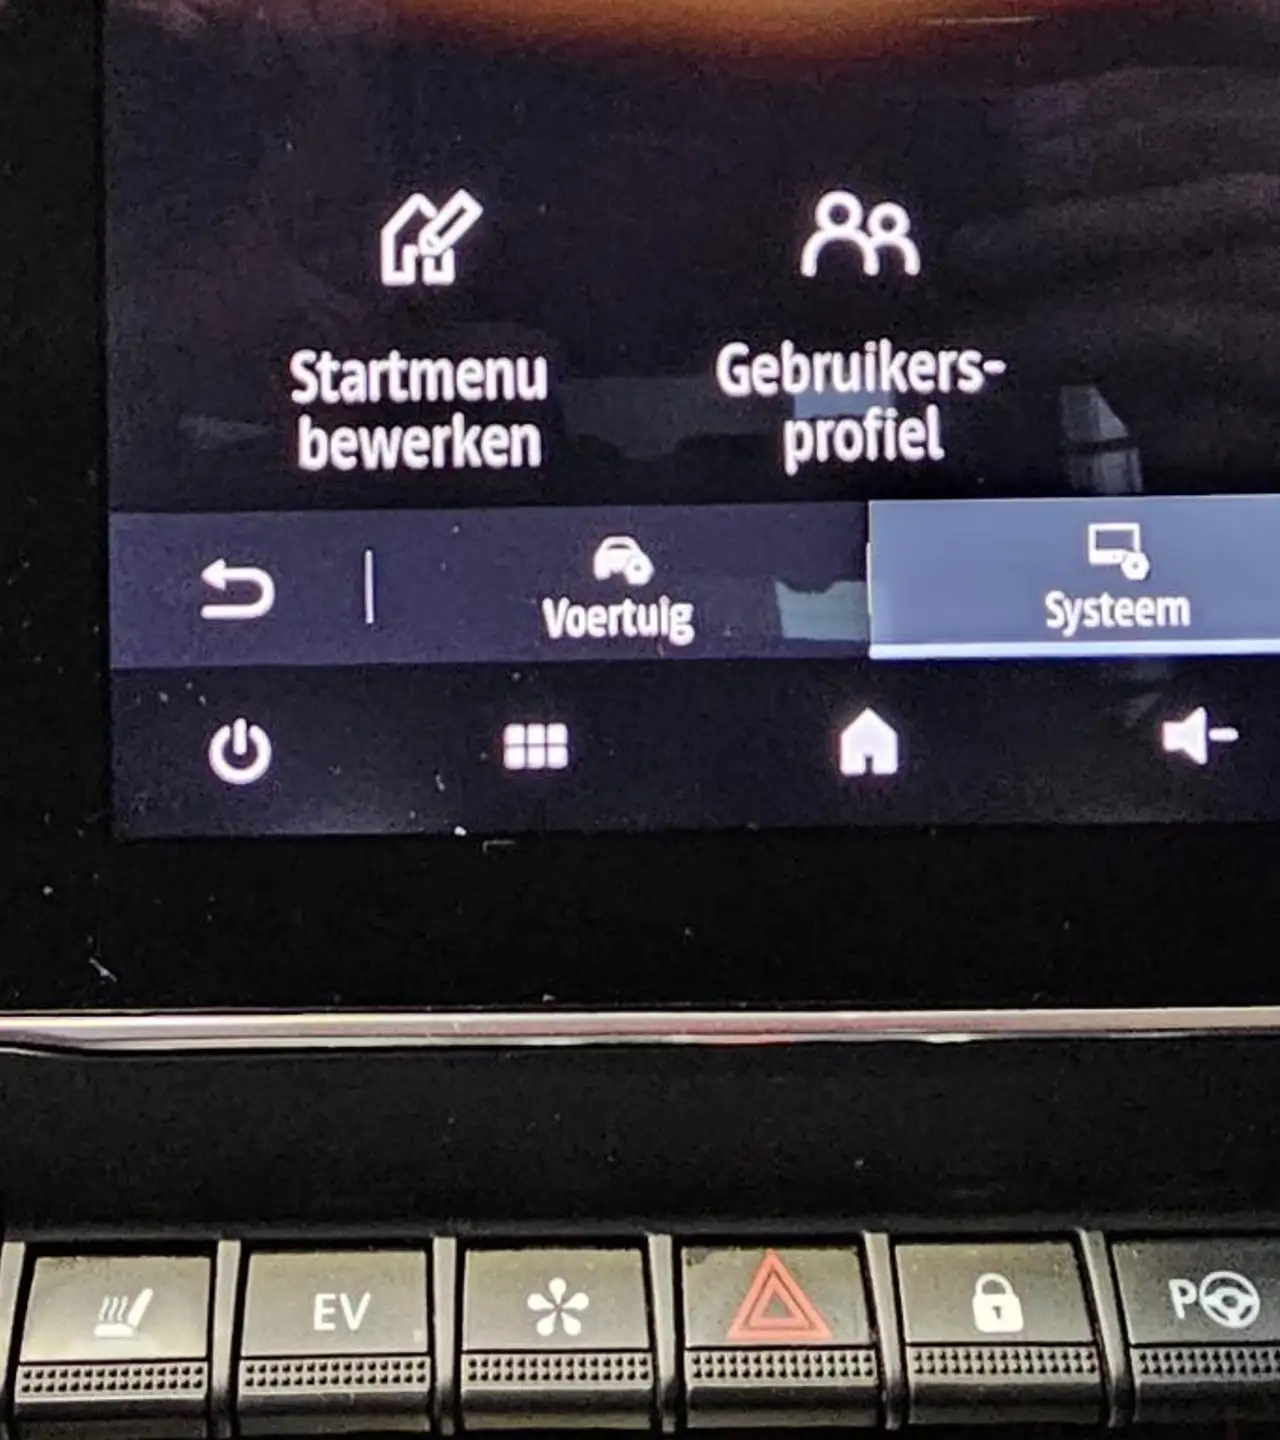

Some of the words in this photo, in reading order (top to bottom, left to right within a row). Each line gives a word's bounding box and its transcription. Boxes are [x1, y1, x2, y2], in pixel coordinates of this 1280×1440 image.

[290, 349, 548, 404] Startmenu
[716, 338, 1007, 397] Gebruikers-
[298, 412, 542, 471] bewerken
[784, 404, 946, 475] profiel
[542, 595, 696, 646] Voertuig
[1045, 590, 1191, 637] Systeem
[313, 1292, 371, 1331] EV
[1168, 1278, 1197, 1320] P
